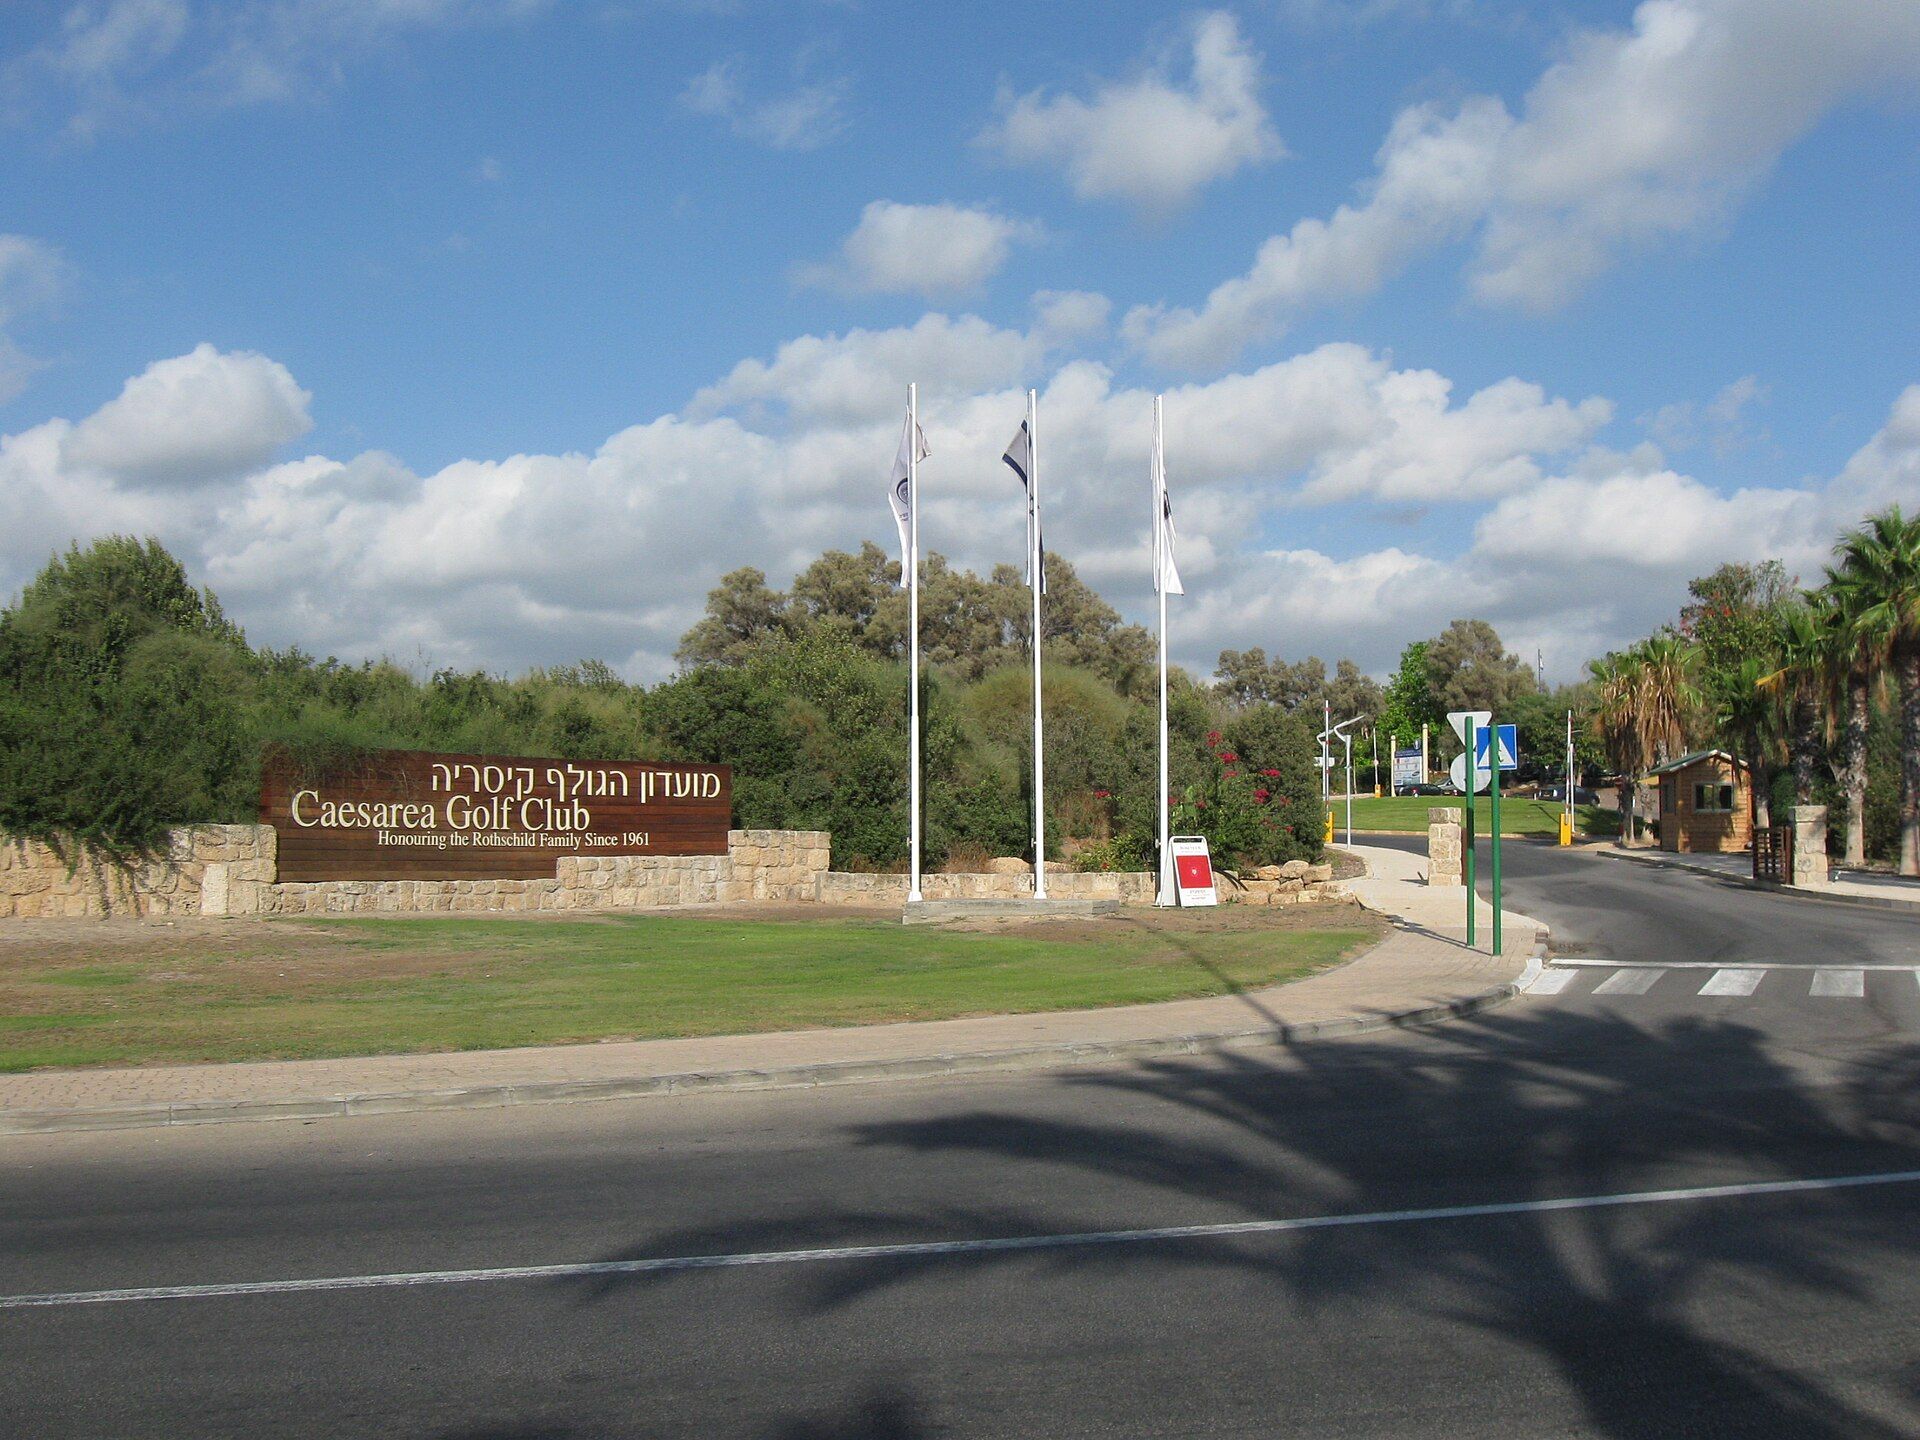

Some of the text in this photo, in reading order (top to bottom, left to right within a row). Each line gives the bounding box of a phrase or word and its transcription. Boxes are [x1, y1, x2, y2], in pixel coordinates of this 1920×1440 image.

[432, 763, 721, 803] מועדון הגולף קיסריה
[291, 790, 591, 831] Caesarea Golf Club
[377, 830, 650, 850] Honouring the Rothschild Family Since 1961
